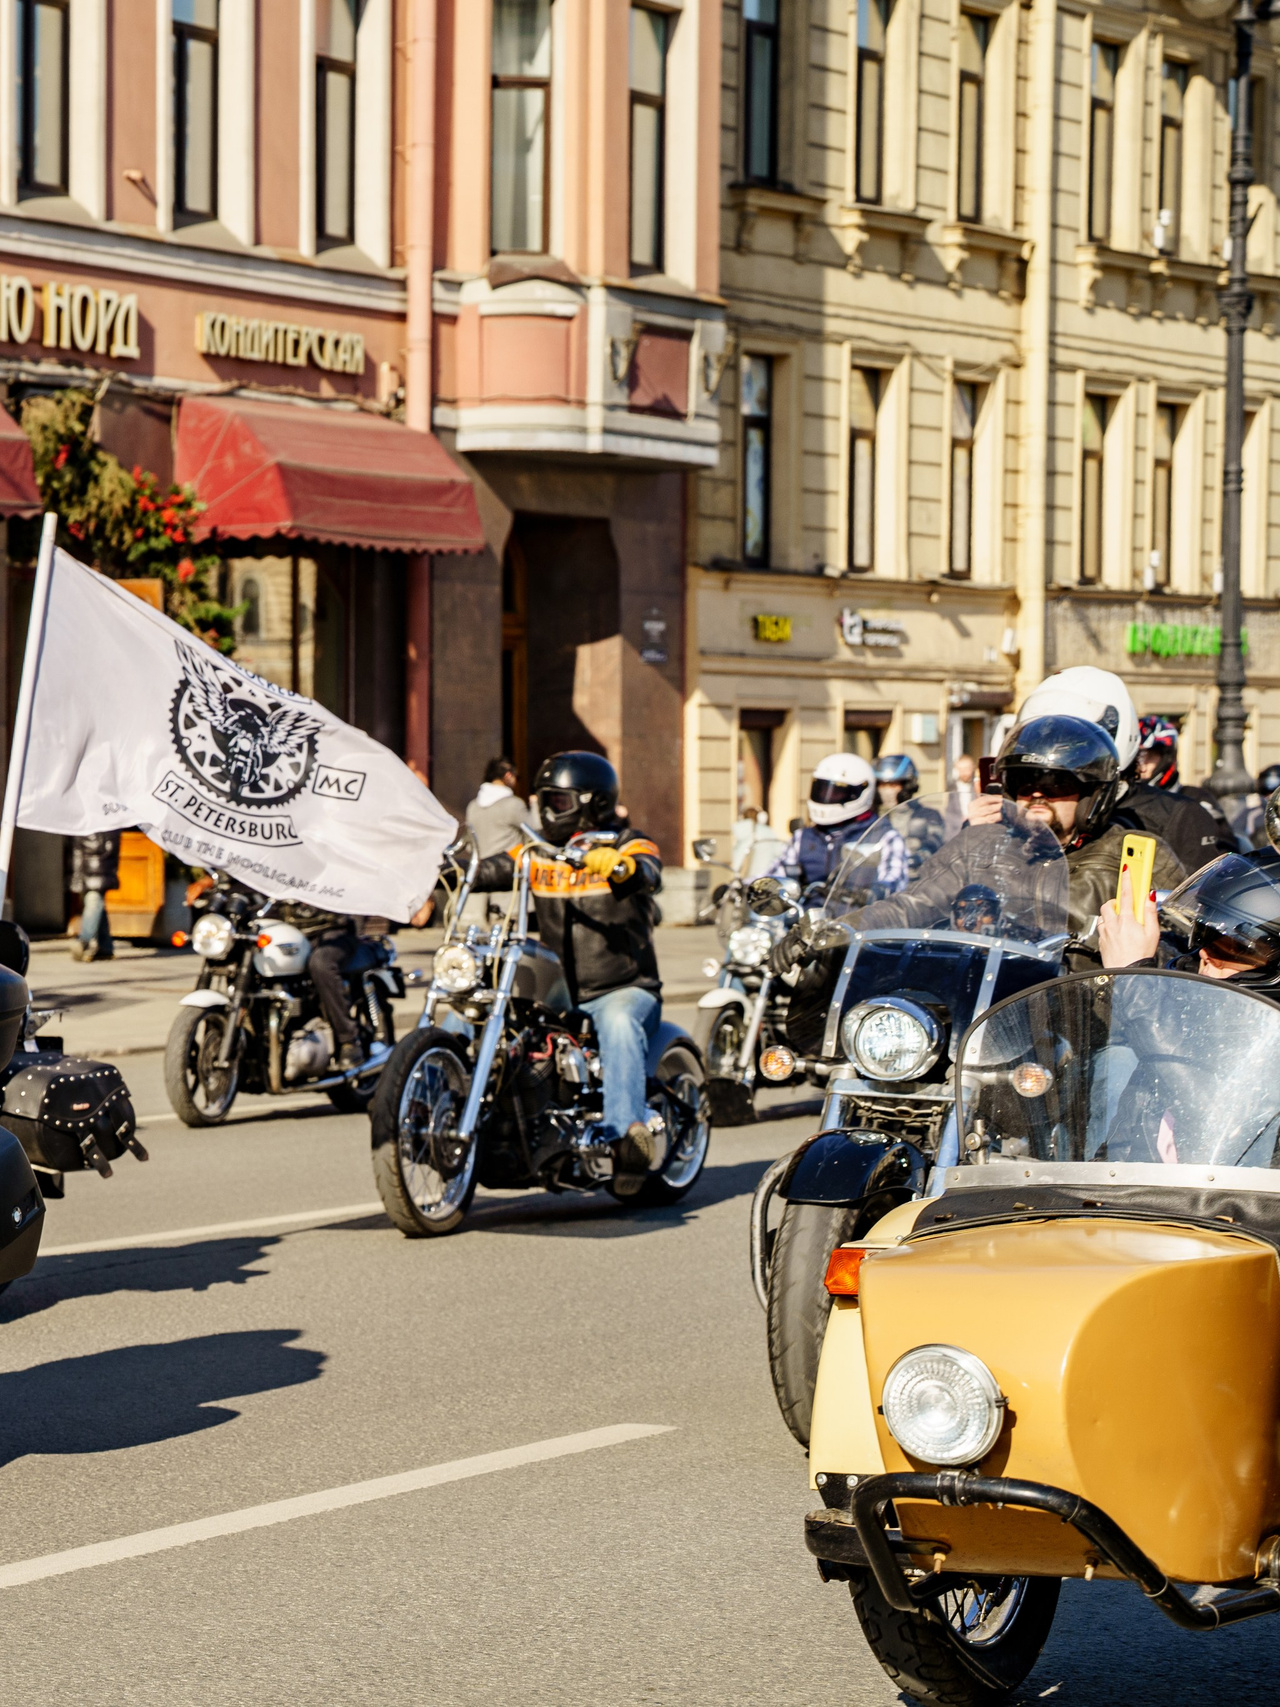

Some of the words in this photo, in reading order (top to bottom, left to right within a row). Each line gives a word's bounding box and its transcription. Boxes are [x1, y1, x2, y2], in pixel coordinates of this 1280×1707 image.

[42, 281, 140, 359] НОРД
[195, 311, 365, 375] КОНДИТЕРСКАЯ
[160, 780, 185, 802] ST.
[318, 774, 358, 796] MC
[196, 840, 225, 860] THE
